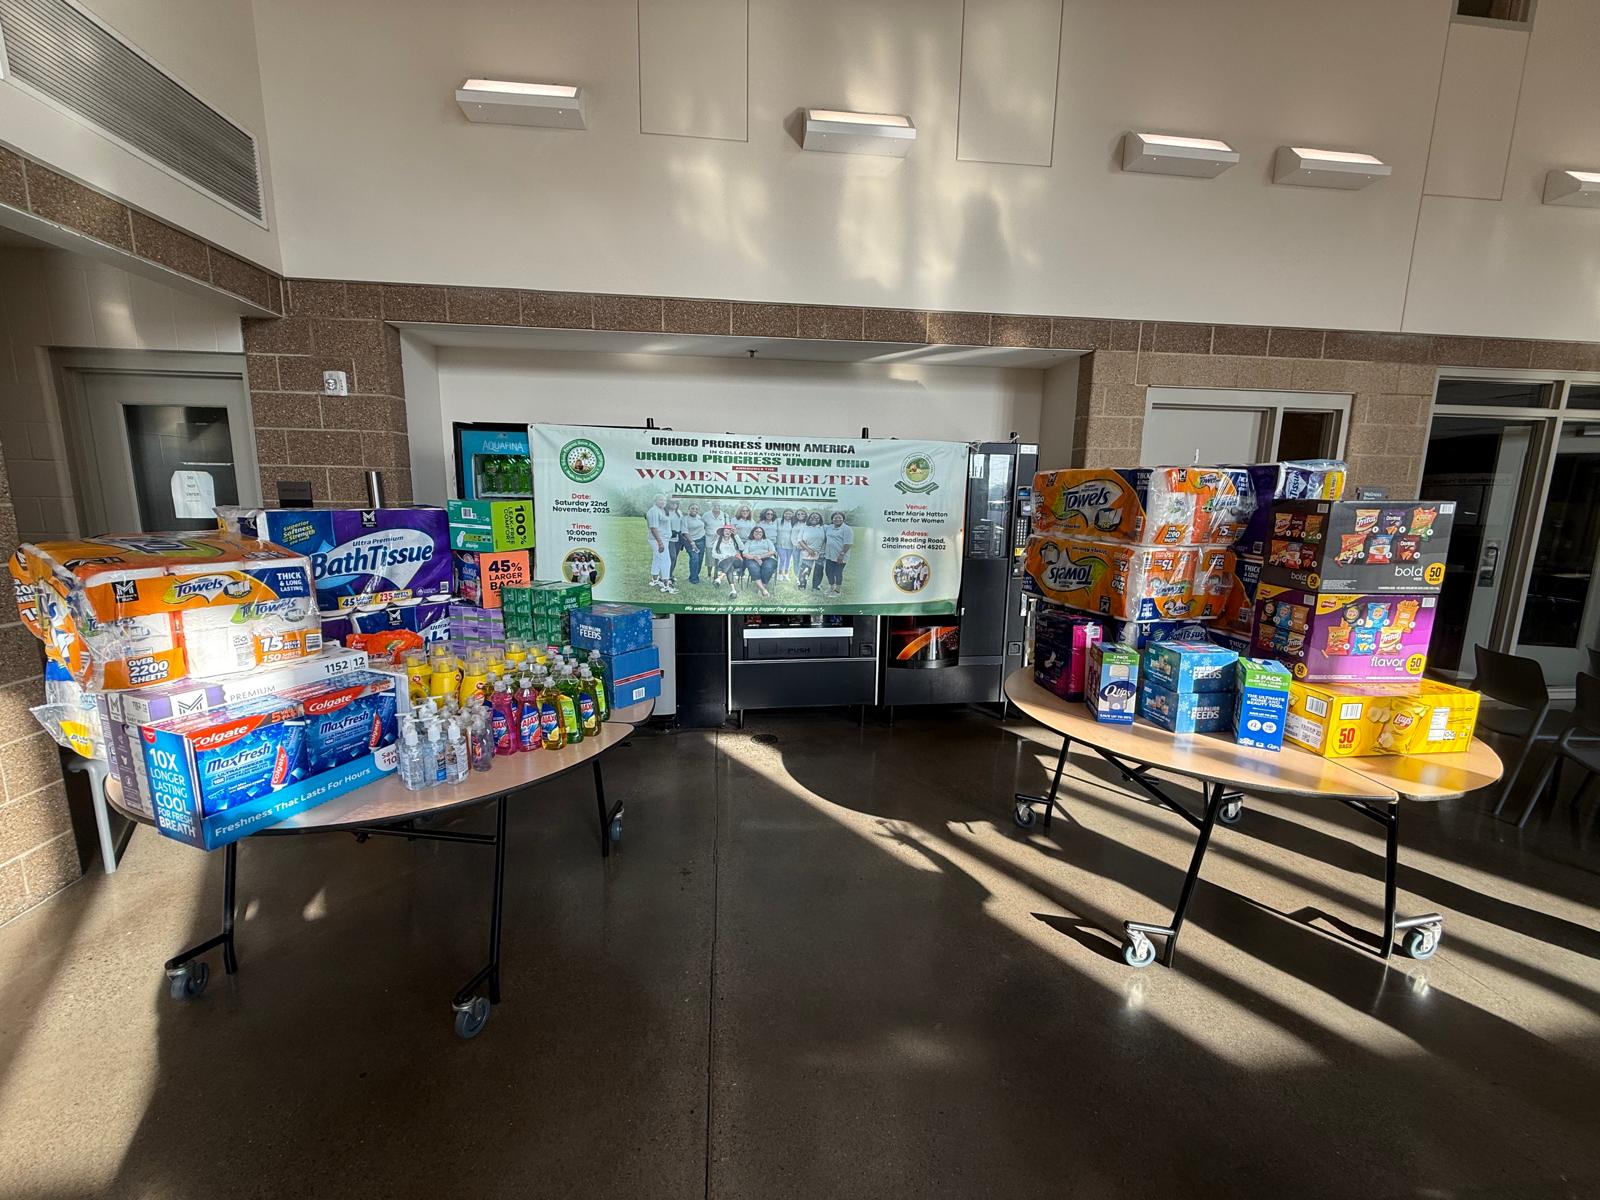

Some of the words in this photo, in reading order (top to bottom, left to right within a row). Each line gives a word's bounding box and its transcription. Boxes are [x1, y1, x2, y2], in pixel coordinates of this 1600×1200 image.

[482, 439, 525, 453] AQUAFINA
[651, 436, 699, 447] URHOBO
[701, 439, 762, 451] PROGRESS
[765, 442, 801, 452] UNION
[804, 443, 856, 454] AMERICA
[635, 451, 698, 463] URHOBO
[702, 454, 782, 466] PROGRESS
[785, 457, 832, 468] UNION
[836, 459, 870, 469] OHIO
[635, 468, 730, 482] WOMEN
[736, 472, 759, 483] IN
[766, 473, 870, 486] SHELTER
[674, 483, 742, 495] NATIONAL
[743, 485, 770, 496] DAY
[772, 485, 836, 498] INITIATIVE
[1063, 487, 1110, 511] Towels
[552, 506, 591, 514] November,
[283, 525, 313, 538] Softness
[507, 506, 516, 545] LEAK-FREE
[514, 504, 527, 545] 100%
[288, 530, 316, 541] Strength
[372, 536, 404, 545] Premium
[488, 559, 523, 574] 45%
[1244, 564, 1260, 572] THICK
[1394, 565, 1424, 577] bold
[1429, 567, 1442, 577] 50
[277, 572, 302, 580] THICK
[489, 572, 523, 581] LARGER
[1049, 565, 1093, 585] Towels
[1291, 572, 1307, 580] bold
[174, 579, 224, 597] Towels
[342, 598, 355, 607] 45
[379, 592, 393, 602] 235
[579, 629, 602, 640] FEEDS
[261, 637, 284, 652] 15
[128, 657, 154, 666] OVER
[263, 653, 282, 663] 150
[325, 660, 348, 673] 1152
[353, 656, 365, 667] 12
[1371, 656, 1405, 667] flavor
[1410, 658, 1422, 668] 50
[130, 660, 169, 677] 2200
[130, 672, 168, 683] SHEETS
[230, 685, 276, 702] PREMIUM
[309, 694, 353, 713] Colgate
[271, 711, 281, 723] 5
[320, 711, 369, 734] MaxFresh
[522, 716, 539, 727] AJAX
[541, 715, 556, 723] AJAX
[1191, 710, 1220, 720] FEEDS
[193, 725, 249, 748] Colgate
[1339, 728, 1355, 743] 50
[149, 748, 179, 772] 10X
[206, 742, 271, 774] MaxFresh
[273, 753, 286, 784] Colgate
[149, 767, 186, 786] LONGER
[152, 779, 188, 798] LASTING
[155, 792, 191, 815] COOL
[215, 809, 273, 837] Freshness
[274, 796, 300, 813] That
[300, 786, 327, 802] Lasts
[327, 779, 343, 791] For
[344, 767, 371, 783] Hours
[157, 806, 172, 819] FOR
[171, 810, 194, 826] FRESH
[158, 816, 197, 838] BREATH
